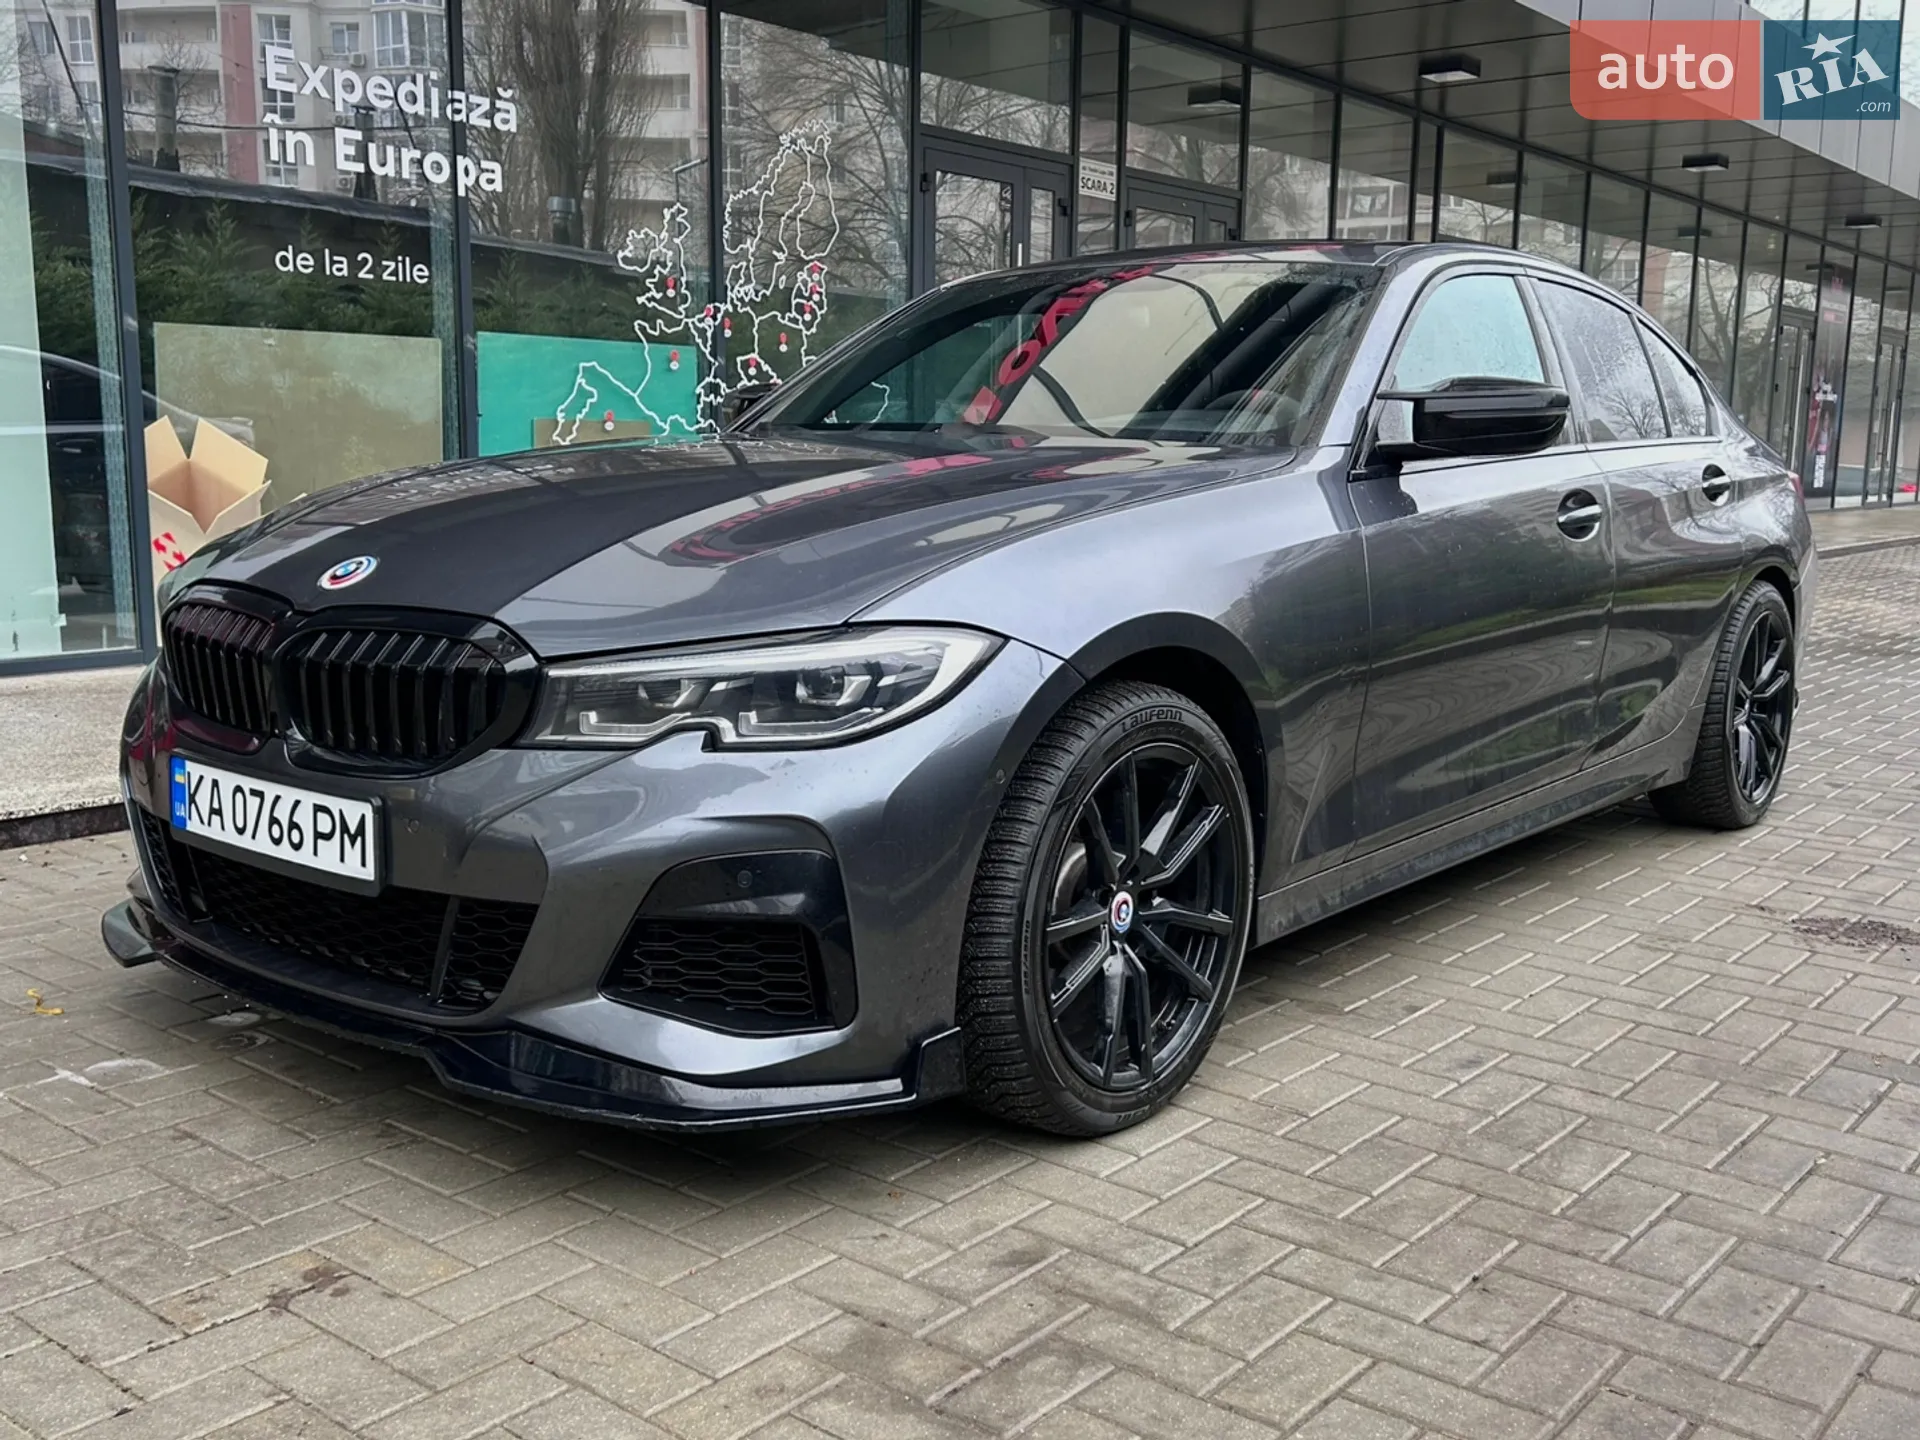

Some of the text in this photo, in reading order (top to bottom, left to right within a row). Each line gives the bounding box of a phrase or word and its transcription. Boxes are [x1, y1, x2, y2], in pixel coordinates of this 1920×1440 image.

[265, 44, 517, 133] Expediază
[262, 112, 503, 198] în Europa
[1081, 176, 1115, 195] SCARA 2
[274, 244, 430, 284] de la 2 zile
[174, 801, 186, 817] UA
